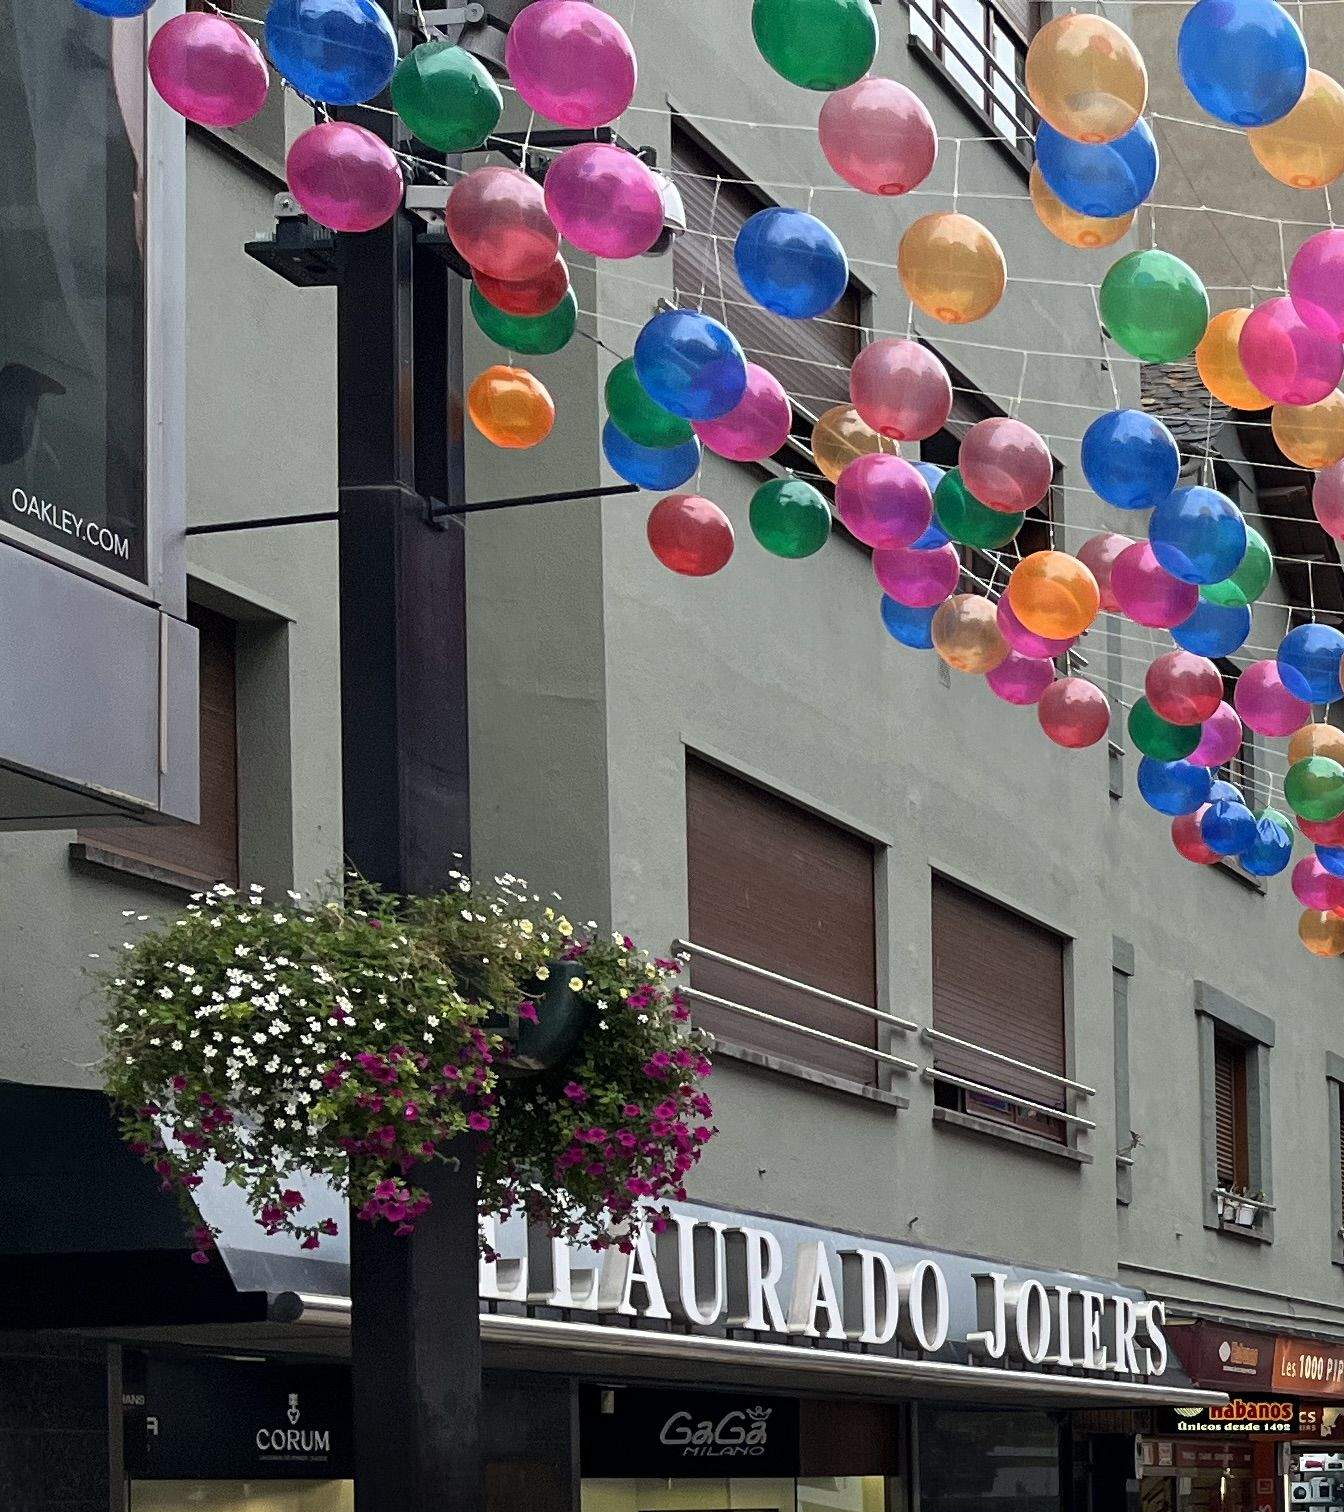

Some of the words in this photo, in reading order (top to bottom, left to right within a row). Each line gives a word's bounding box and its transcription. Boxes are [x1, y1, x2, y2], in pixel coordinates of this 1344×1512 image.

[12, 488, 129, 560] OAKLEY.COM
[966, 1271, 1168, 1377] JOIERS
[1281, 1357, 1296, 1377] Les
[1300, 1354, 1323, 1380] 1000
[1209, 1399, 1294, 1421] Habanos
[1224, 1421, 1260, 1432] desde
[1264, 1422, 1291, 1432] 1492
[256, 1429, 330, 1451] CORUM
[683, 1446, 765, 1457] MILANO
